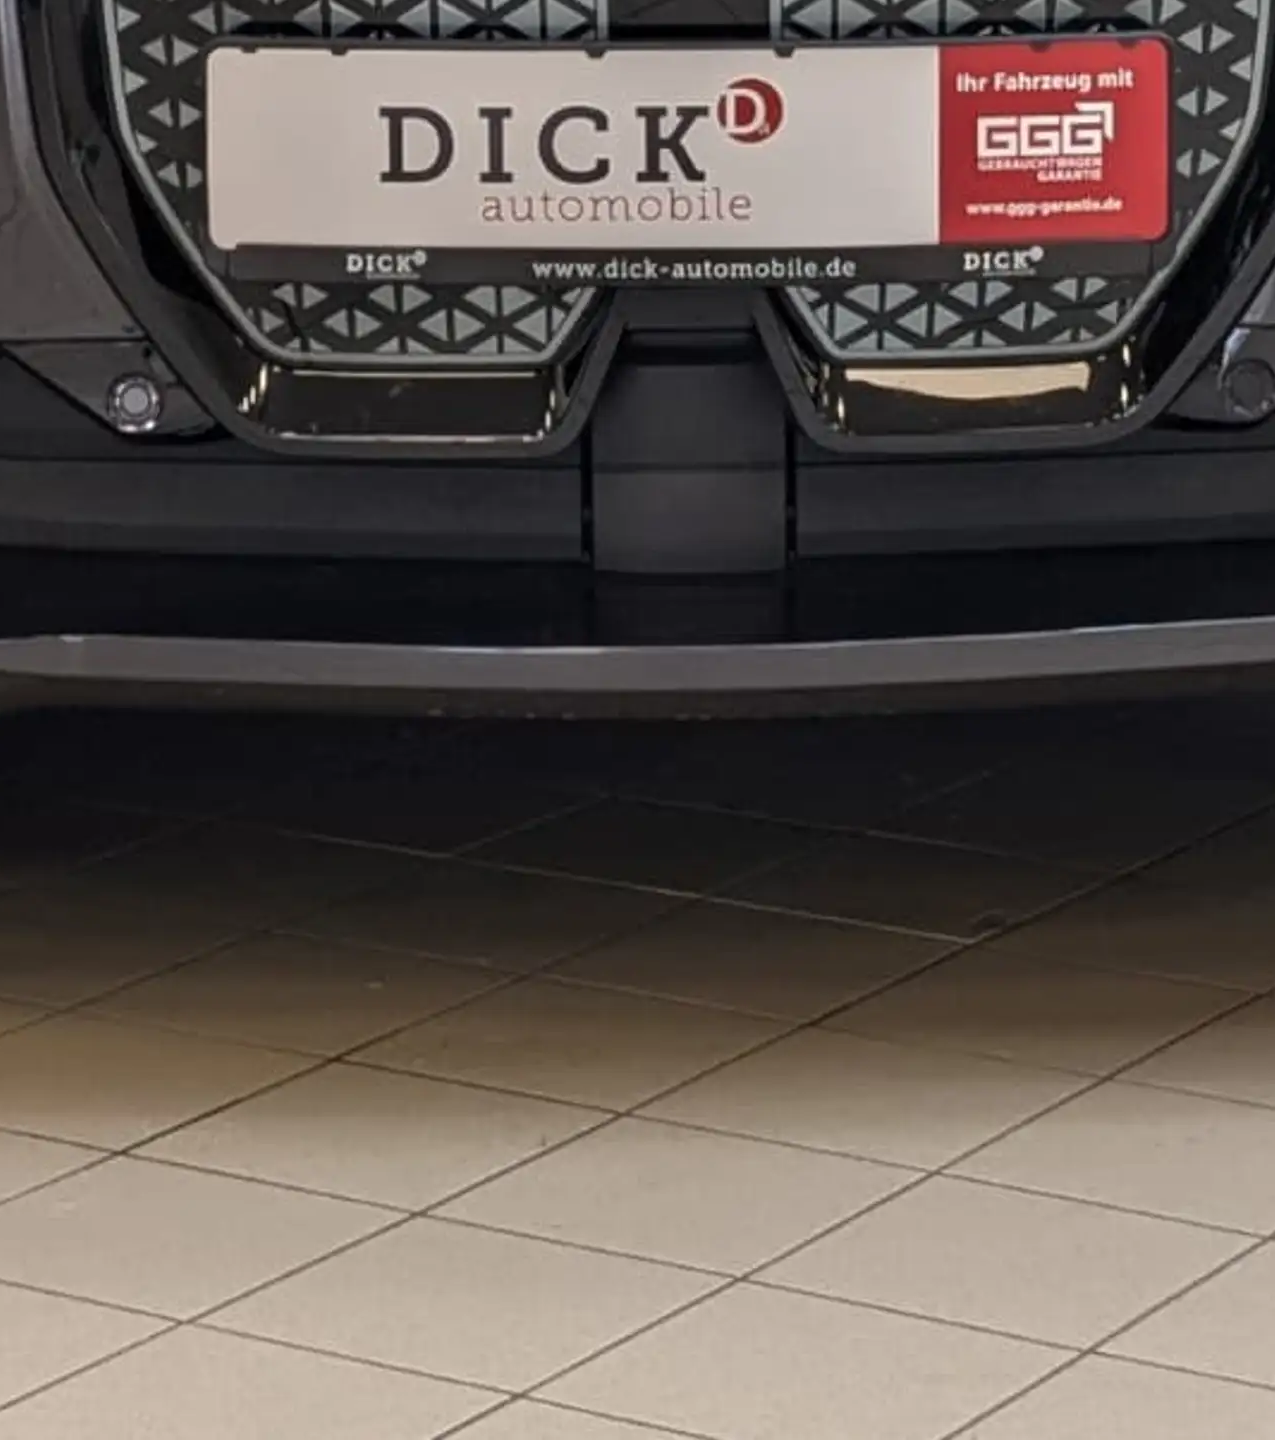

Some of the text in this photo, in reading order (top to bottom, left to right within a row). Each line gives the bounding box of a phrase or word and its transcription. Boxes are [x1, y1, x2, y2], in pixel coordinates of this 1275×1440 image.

[956, 68, 1134, 94] Ihr Fahrzeug mit
[379, 105, 710, 184] DICK
[977, 113, 1104, 157] GGG
[1036, 169, 1103, 182] GARANTIE
[481, 188, 753, 222] automobile
[965, 196, 1124, 217] www.ggg-garantie.de
[346, 252, 414, 273] DICK
[532, 257, 857, 279] www.dick-automobile.de
[963, 251, 1029, 272] DICK
